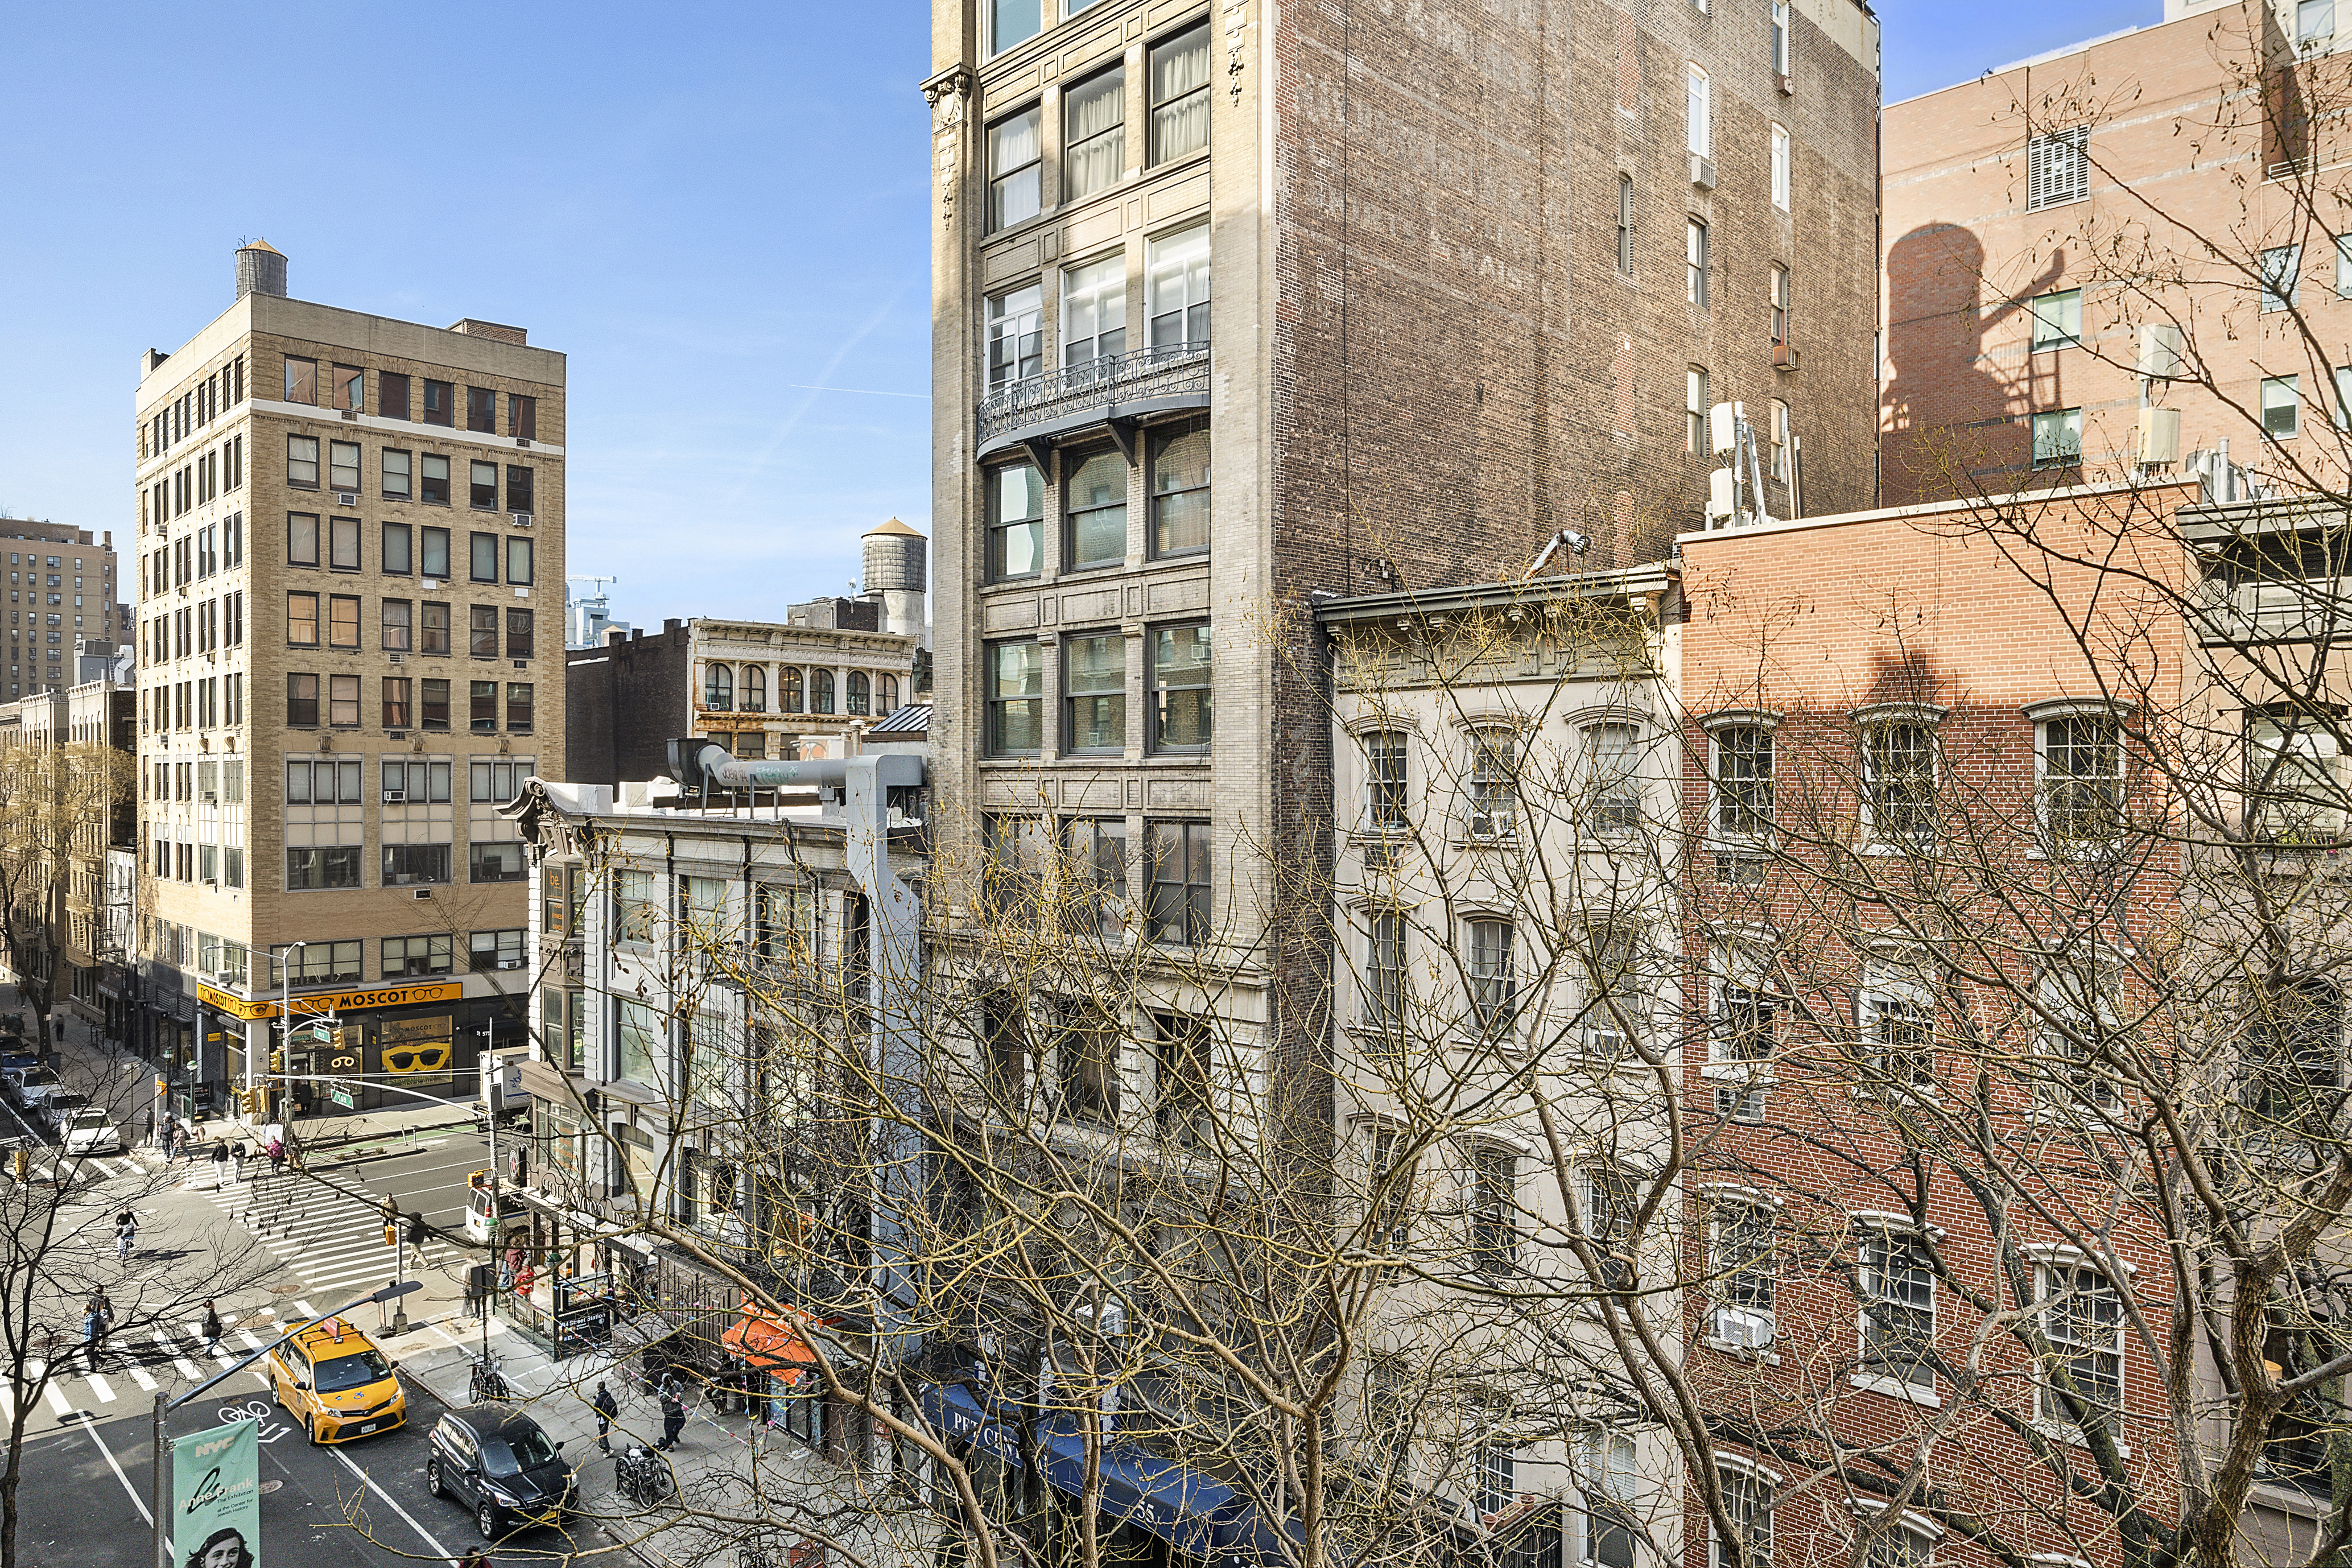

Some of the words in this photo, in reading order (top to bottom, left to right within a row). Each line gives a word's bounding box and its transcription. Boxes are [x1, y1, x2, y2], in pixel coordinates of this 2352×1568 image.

[209, 987, 227, 1008] MOSCOT
[339, 991, 407, 1008] MOSCOT
[570, 1318, 586, 1326] Street
[954, 1412, 979, 1438] PET
[196, 1436, 235, 1458] NYC
[178, 1491, 213, 1511] Anne
[216, 1478, 254, 1497] Frank
[228, 1489, 254, 1500] Exhibition
